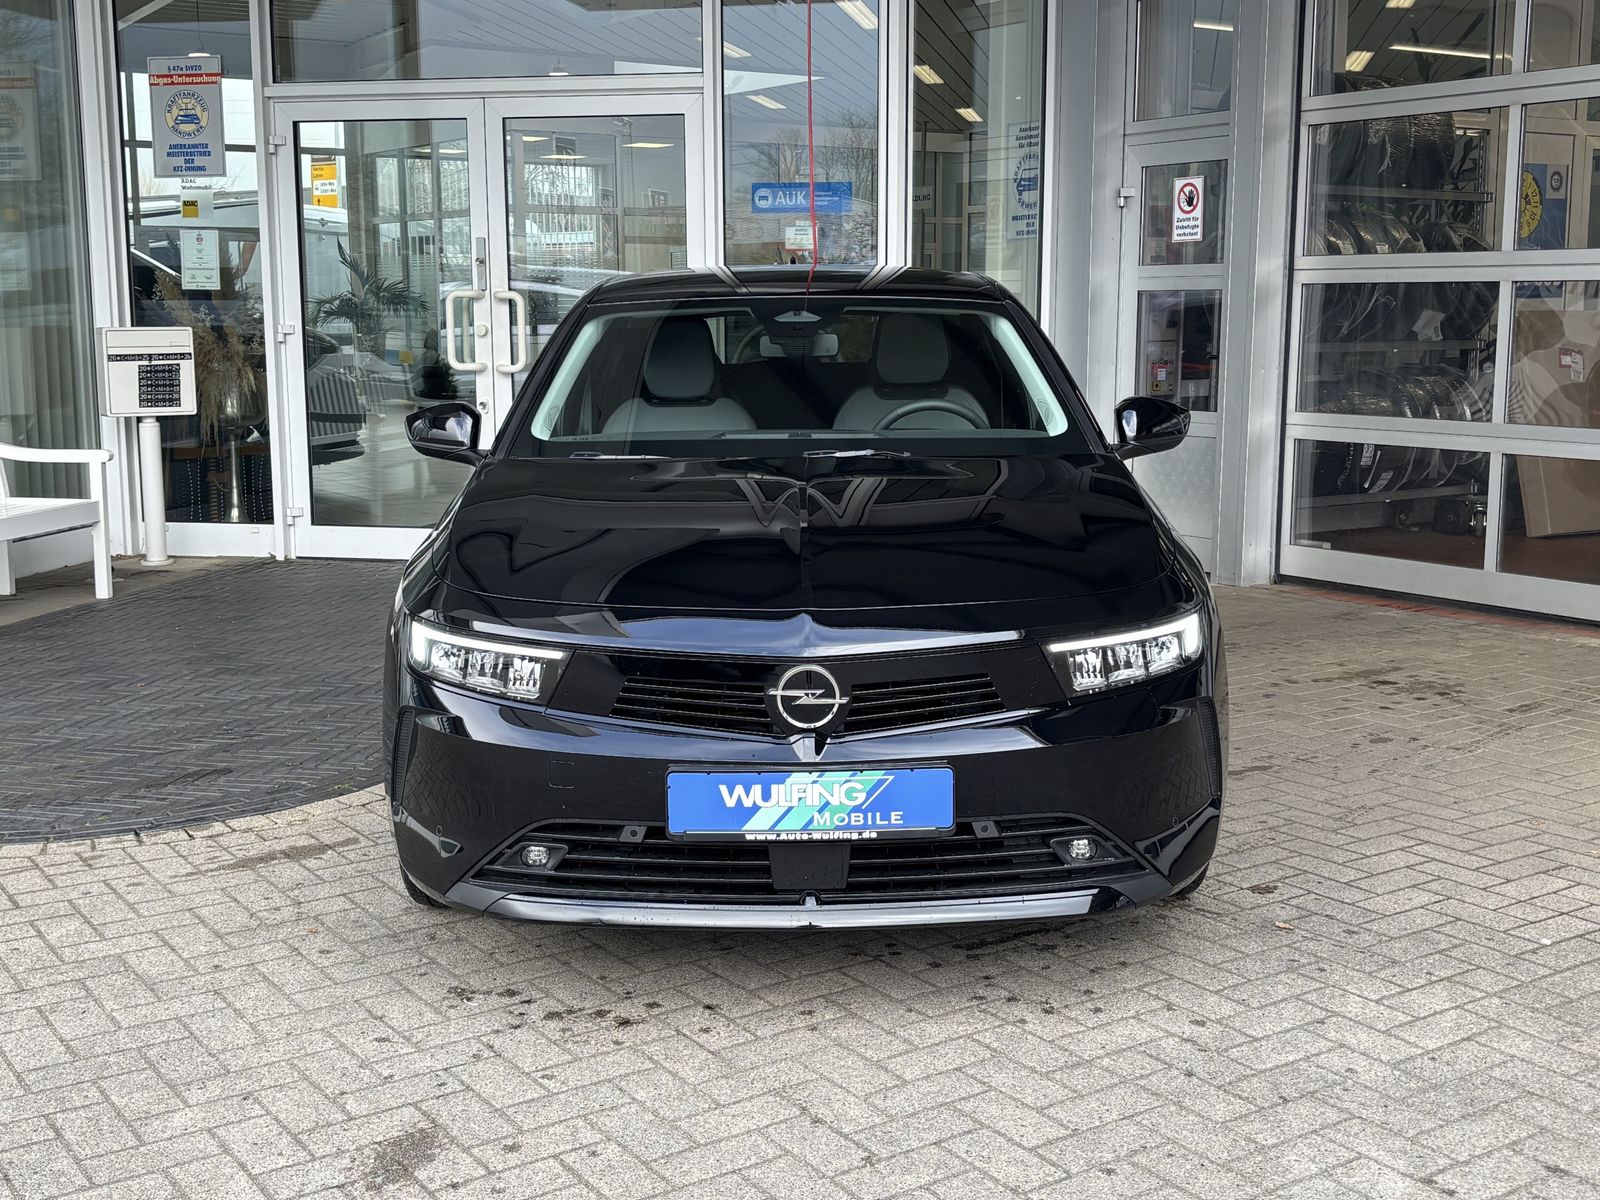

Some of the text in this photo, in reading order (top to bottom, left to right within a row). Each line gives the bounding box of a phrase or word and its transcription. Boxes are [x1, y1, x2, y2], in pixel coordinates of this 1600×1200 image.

[150, 74, 221, 86] Abgas-Untersuchung
[166, 91, 209, 114] KRAFTFAHRZEUG
[170, 124, 206, 138] HANDWERK
[775, 191, 807, 205] AüK
[718, 782, 867, 808] WULFING
[812, 811, 904, 827] MOBILE
